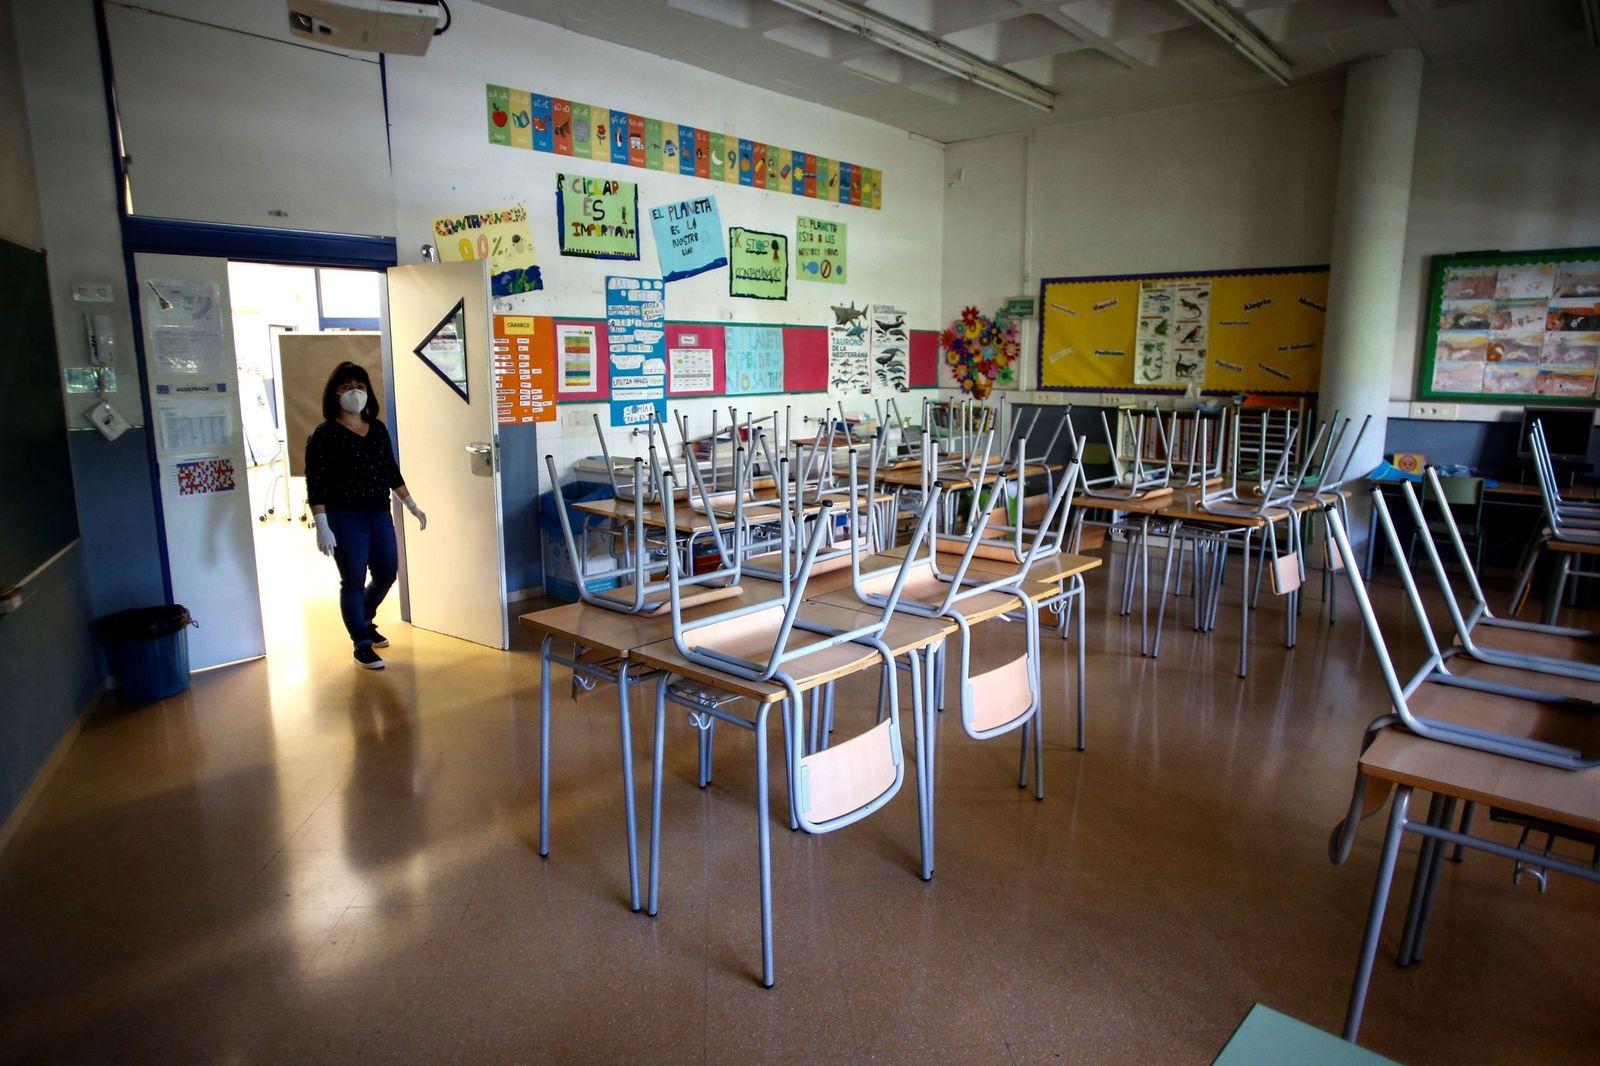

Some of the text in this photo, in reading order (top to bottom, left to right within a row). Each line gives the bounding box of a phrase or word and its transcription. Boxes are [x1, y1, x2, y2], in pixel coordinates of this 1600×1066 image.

[652, 198, 712, 221] EL PLANETA
[572, 222, 635, 239] IMPORTANT
[687, 217, 697, 230] LA
[798, 218, 837, 233] EL PLANETA
[672, 232, 699, 248] NOSTRE
[832, 338, 862, 346] TAURONS
